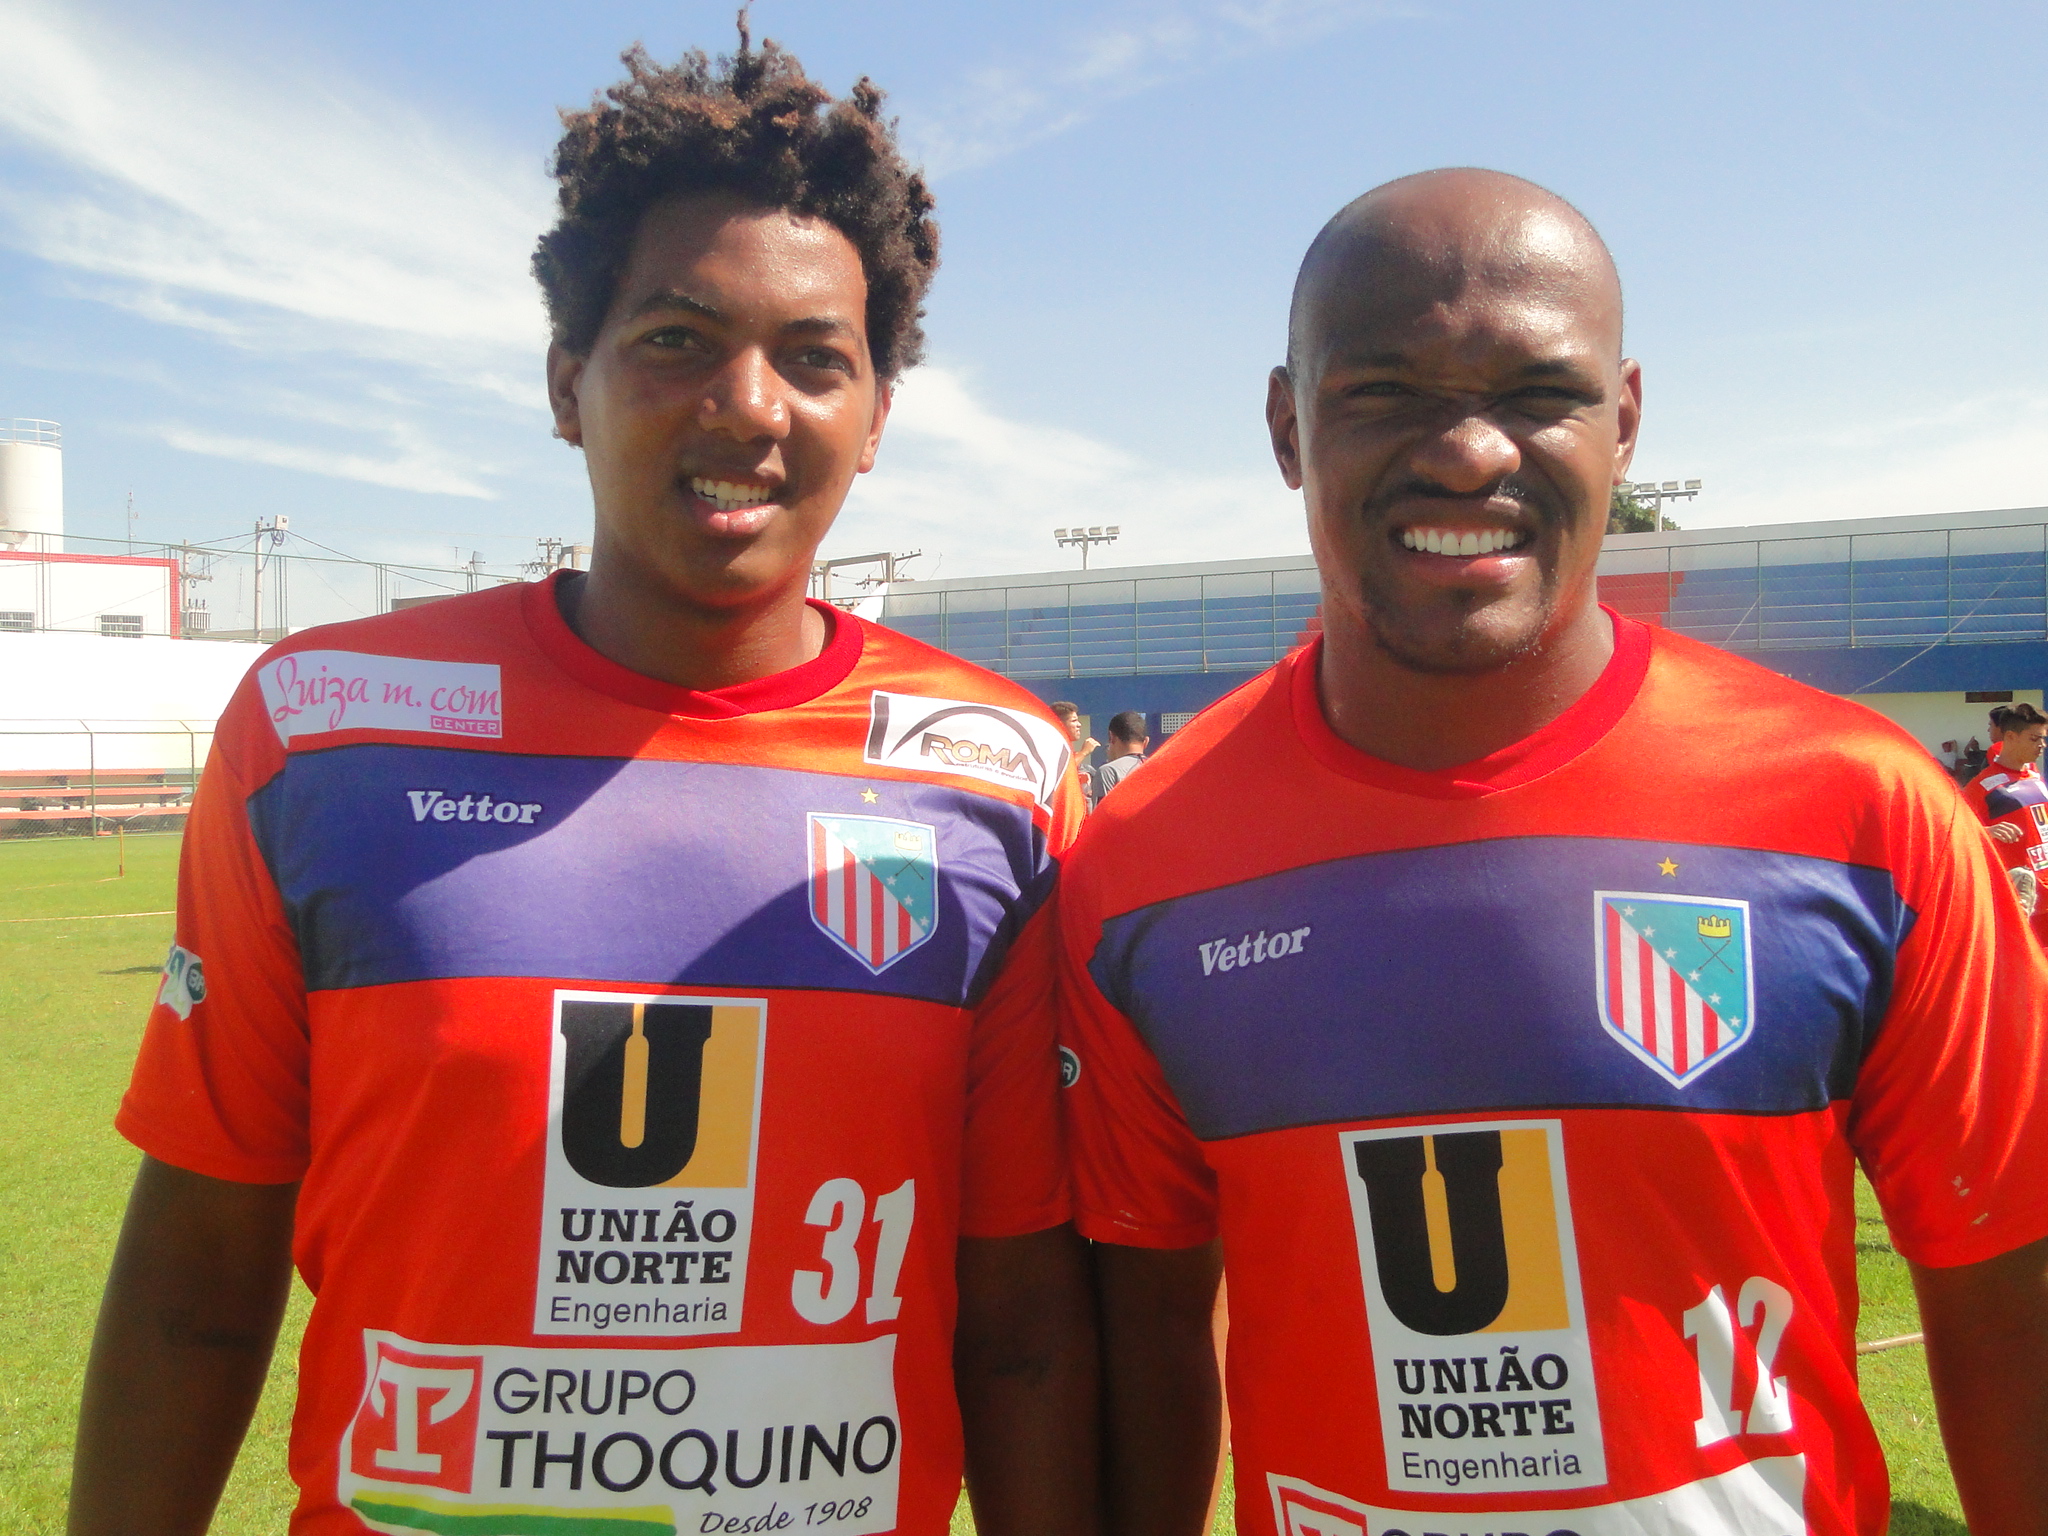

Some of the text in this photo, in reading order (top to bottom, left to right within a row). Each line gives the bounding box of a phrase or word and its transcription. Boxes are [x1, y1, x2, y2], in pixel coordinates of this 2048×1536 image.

[272, 656, 370, 730] Luiza
[432, 717, 498, 733] CENTER
[921, 732, 1038, 784] ROMA
[407, 791, 542, 824] Vettor
[1199, 926, 1311, 976] Vettor
[560, 1200, 737, 1243] UNIÃO
[555, 1250, 733, 1284] NORTE
[791, 1177, 915, 1325] 31
[550, 1296, 728, 1329] Engenharia
[1394, 1346, 1569, 1395] UNIÃO
[1683, 1276, 1793, 1448] 12
[493, 1366, 697, 1416] GRUPO
[1398, 1398, 1575, 1439] NORTE
[486, 1415, 898, 1497] THOQUINO
[1403, 1448, 1582, 1486] Engenharia
[700, 1496, 873, 1534] Desde 1908
